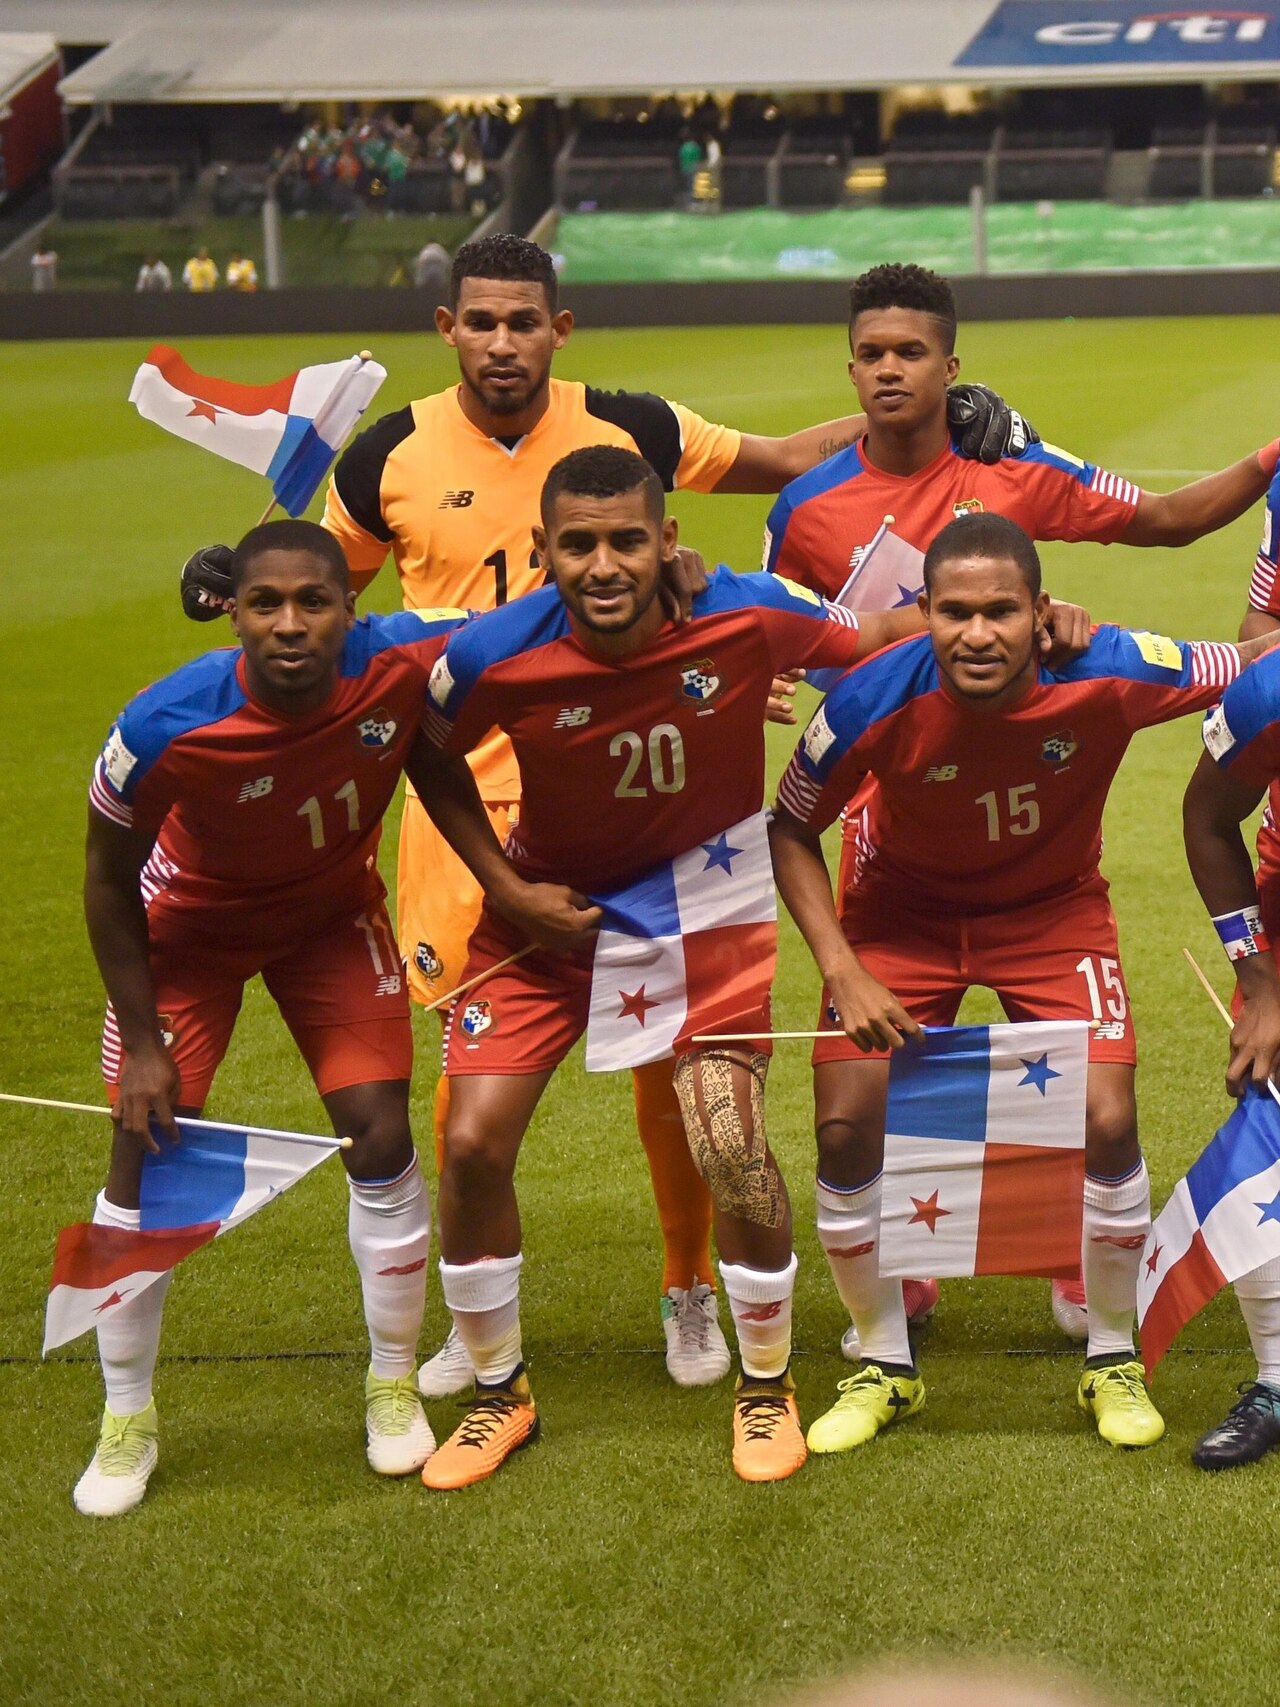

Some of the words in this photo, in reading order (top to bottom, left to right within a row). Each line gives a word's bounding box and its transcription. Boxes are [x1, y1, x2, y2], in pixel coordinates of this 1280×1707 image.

[609, 723, 686, 798] 20
[297, 778, 360, 850] 11
[975, 782, 1041, 842] 15
[354, 912, 400, 975] 11
[1076, 956, 1127, 1020] 15
